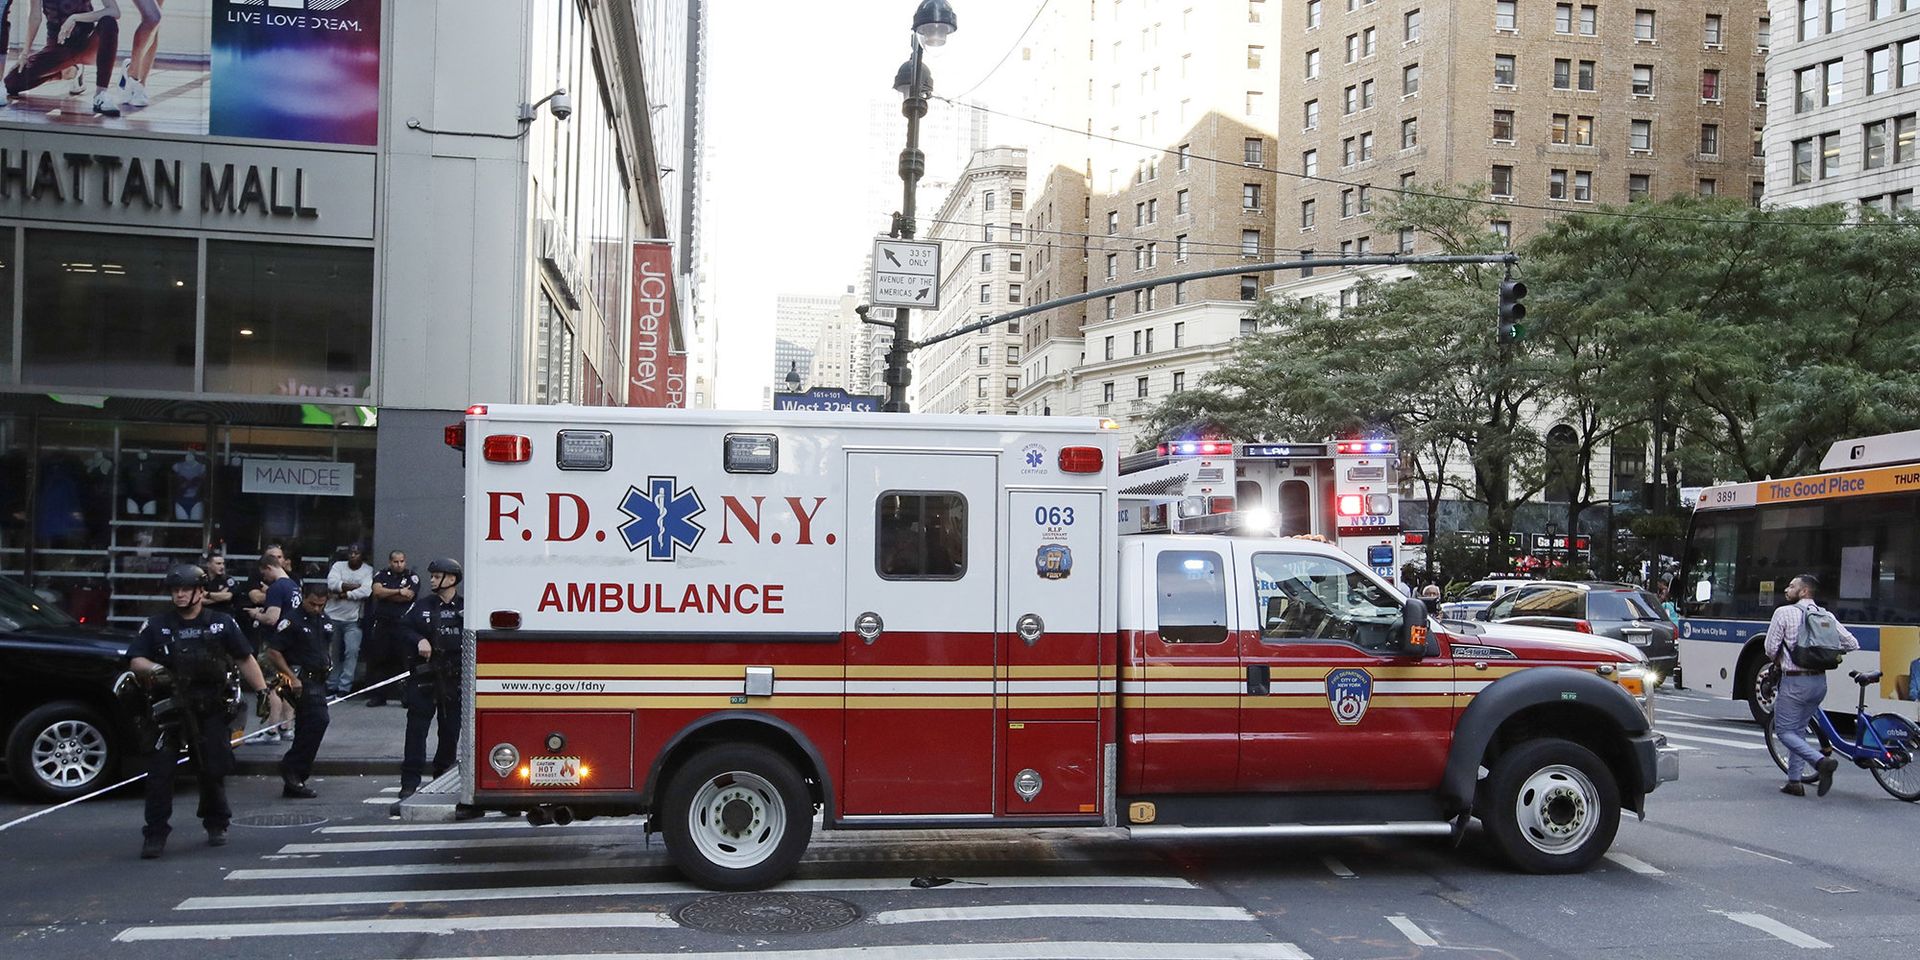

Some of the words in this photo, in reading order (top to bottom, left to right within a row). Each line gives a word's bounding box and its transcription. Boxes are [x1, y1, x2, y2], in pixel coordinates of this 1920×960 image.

[228, 11, 261, 24] LIVE
[267, 14, 305, 28] LOVE
[311, 17, 362, 32] DREAM.
[200, 161, 319, 219] MALL
[909, 249, 920, 257] 33
[922, 250, 932, 258] ST
[908, 258, 928, 267] ONLY
[879, 275, 905, 285] AVENUE
[908, 277, 917, 285] OF
[920, 278, 933, 286] THE
[879, 288, 913, 297] AMERICAS
[631, 261, 666, 393] JCPenney
[781, 400, 820, 411] West
[856, 402, 871, 411] St
[1262, 447, 1290, 456] LAW
[255, 466, 340, 487] MANDEE
[1770, 485, 1791, 500] The
[1793, 480, 1826, 497] Good
[1829, 476, 1865, 493] Place
[1894, 472, 1920, 485] THUR
[1716, 490, 1737, 503] 3891
[1035, 506, 1075, 526] 063
[1351, 516, 1387, 526] NYPD
[537, 582, 785, 614] AMBULANCE
[1710, 628, 1718, 636] City
[1719, 628, 1727, 636] Bus
[501, 680, 606, 693] www.nyc.gov/fdny
